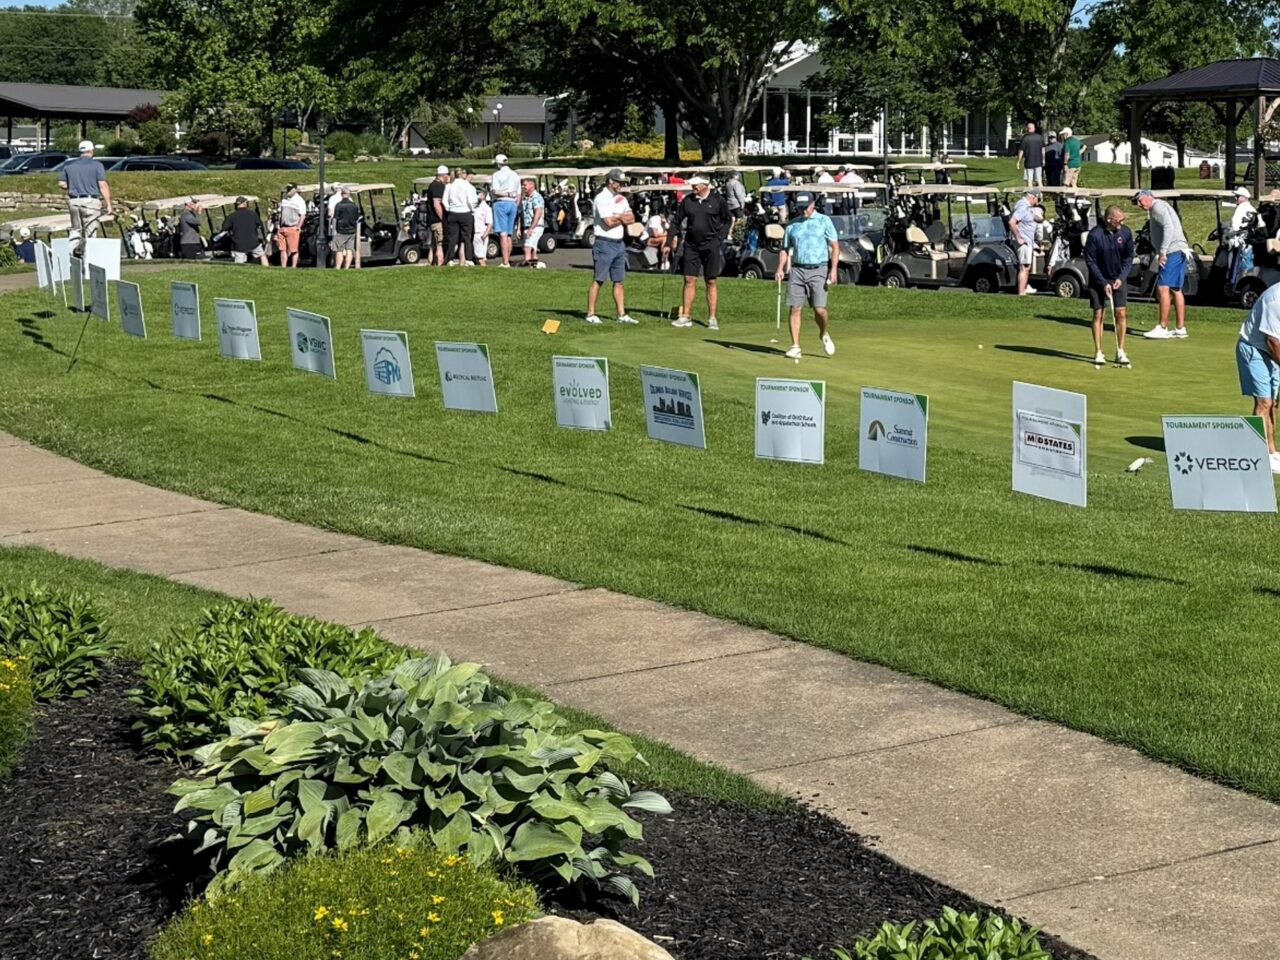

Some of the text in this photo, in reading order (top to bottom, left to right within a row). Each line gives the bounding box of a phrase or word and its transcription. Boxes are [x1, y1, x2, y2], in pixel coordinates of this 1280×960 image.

[862, 391, 915, 405] TOURNAMENT SPONSOR
[1165, 421, 1245, 430] TOURNAMENT SPONSOR
[886, 432, 918, 446] Construction
[1194, 457, 1260, 472] VEREGY
